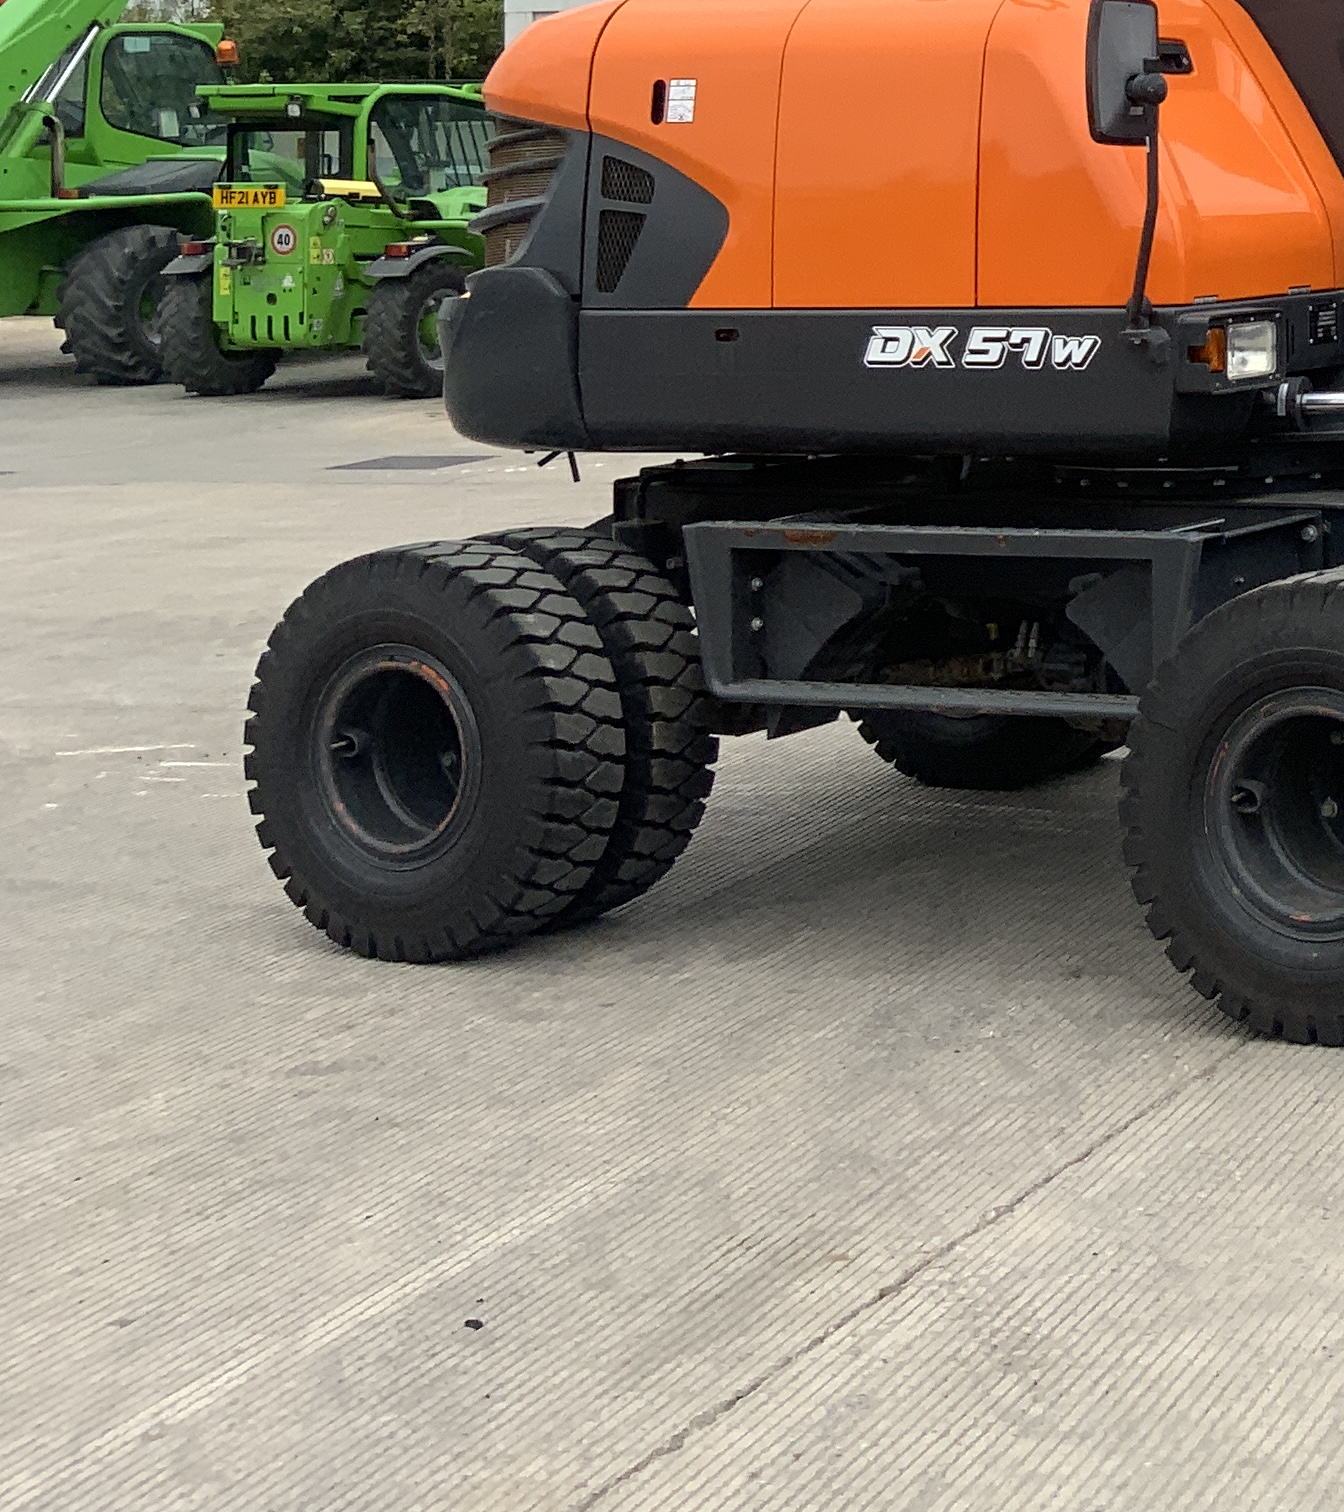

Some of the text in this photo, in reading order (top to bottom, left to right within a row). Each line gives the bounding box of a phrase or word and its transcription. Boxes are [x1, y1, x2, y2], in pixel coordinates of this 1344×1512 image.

[220, 191, 277, 205] HF21 AYB
[277, 234, 291, 246] 40
